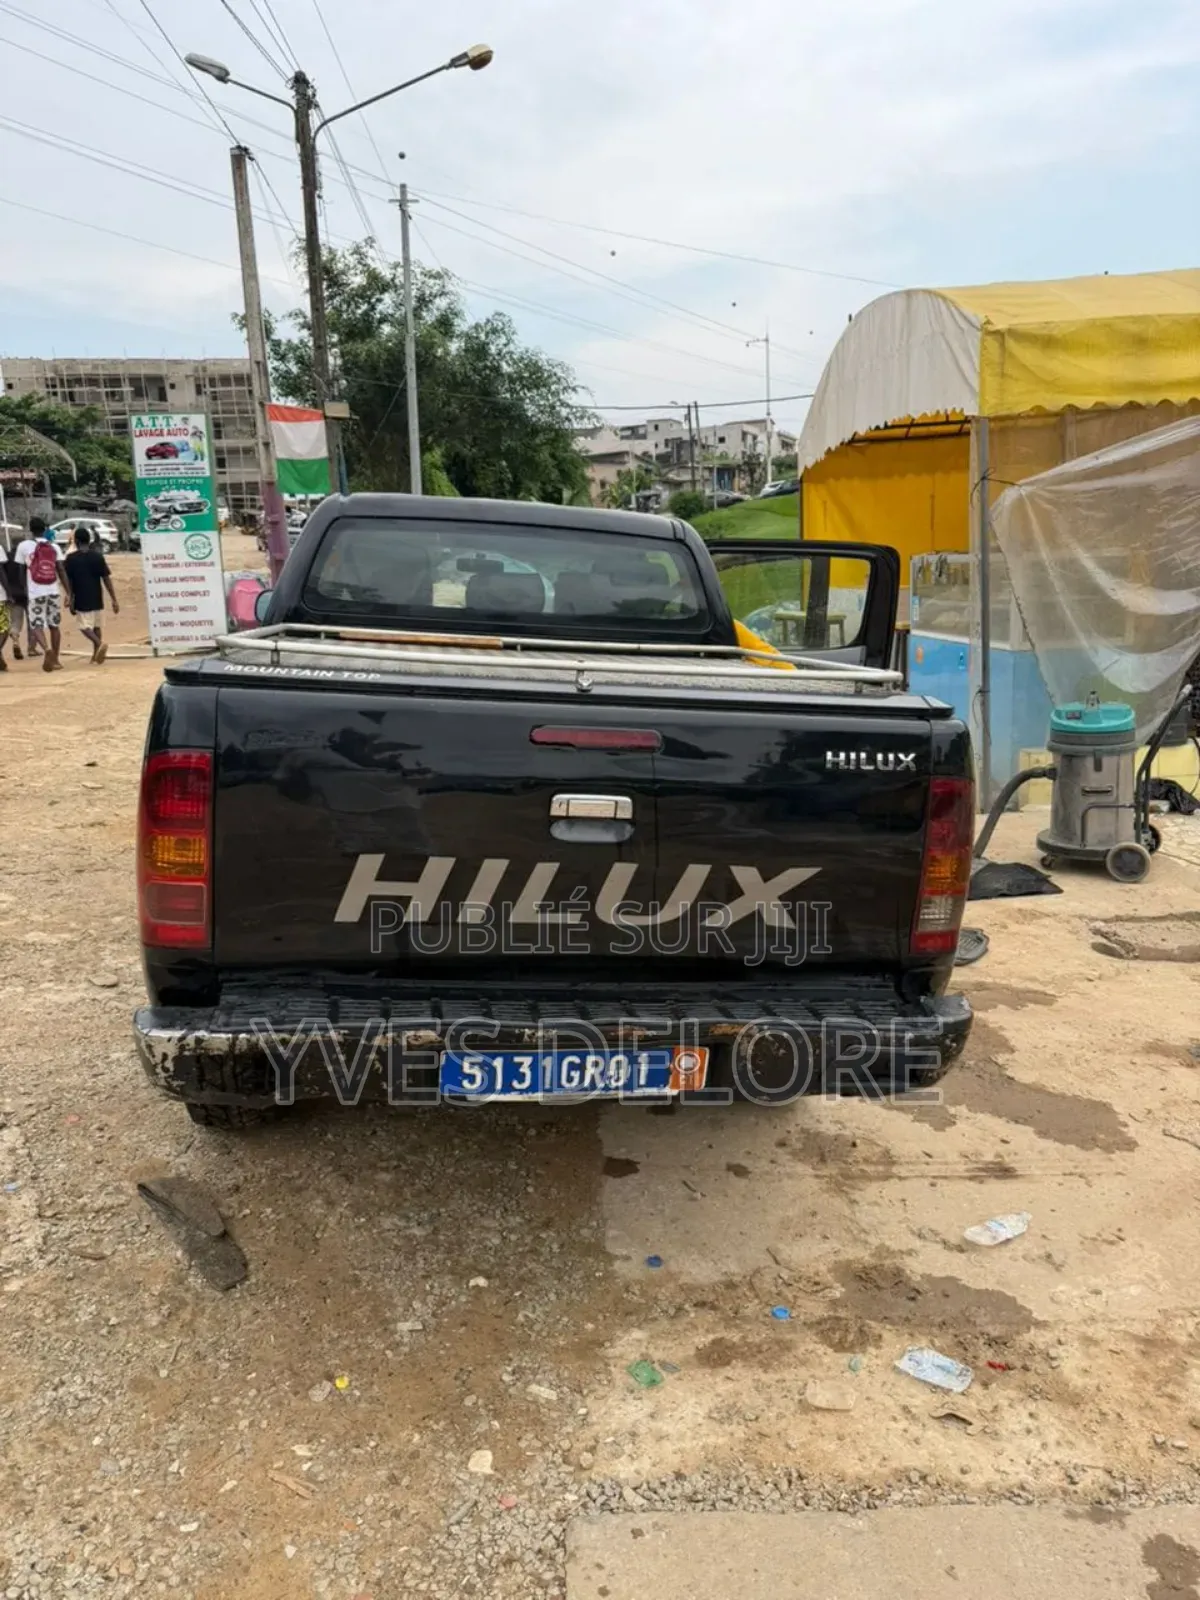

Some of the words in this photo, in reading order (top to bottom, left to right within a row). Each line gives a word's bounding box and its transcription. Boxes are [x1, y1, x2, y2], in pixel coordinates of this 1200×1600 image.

[135, 416, 177, 428] A.T.T.
[134, 428, 165, 438] LAVAGE
[166, 427, 189, 437] AUTO
[154, 576, 177, 584] LAVAGE
[180, 590, 210, 598] COMPLET
[178, 605, 198, 613] MOTO
[180, 619, 214, 627] MOQUETTE
[224, 664, 334, 678] MOUNTAIN
[343, 672, 380, 680] TOP
[826, 751, 917, 771] HILUX
[334, 853, 823, 929] HILUX
[461, 1053, 650, 1090] 5131GR01
